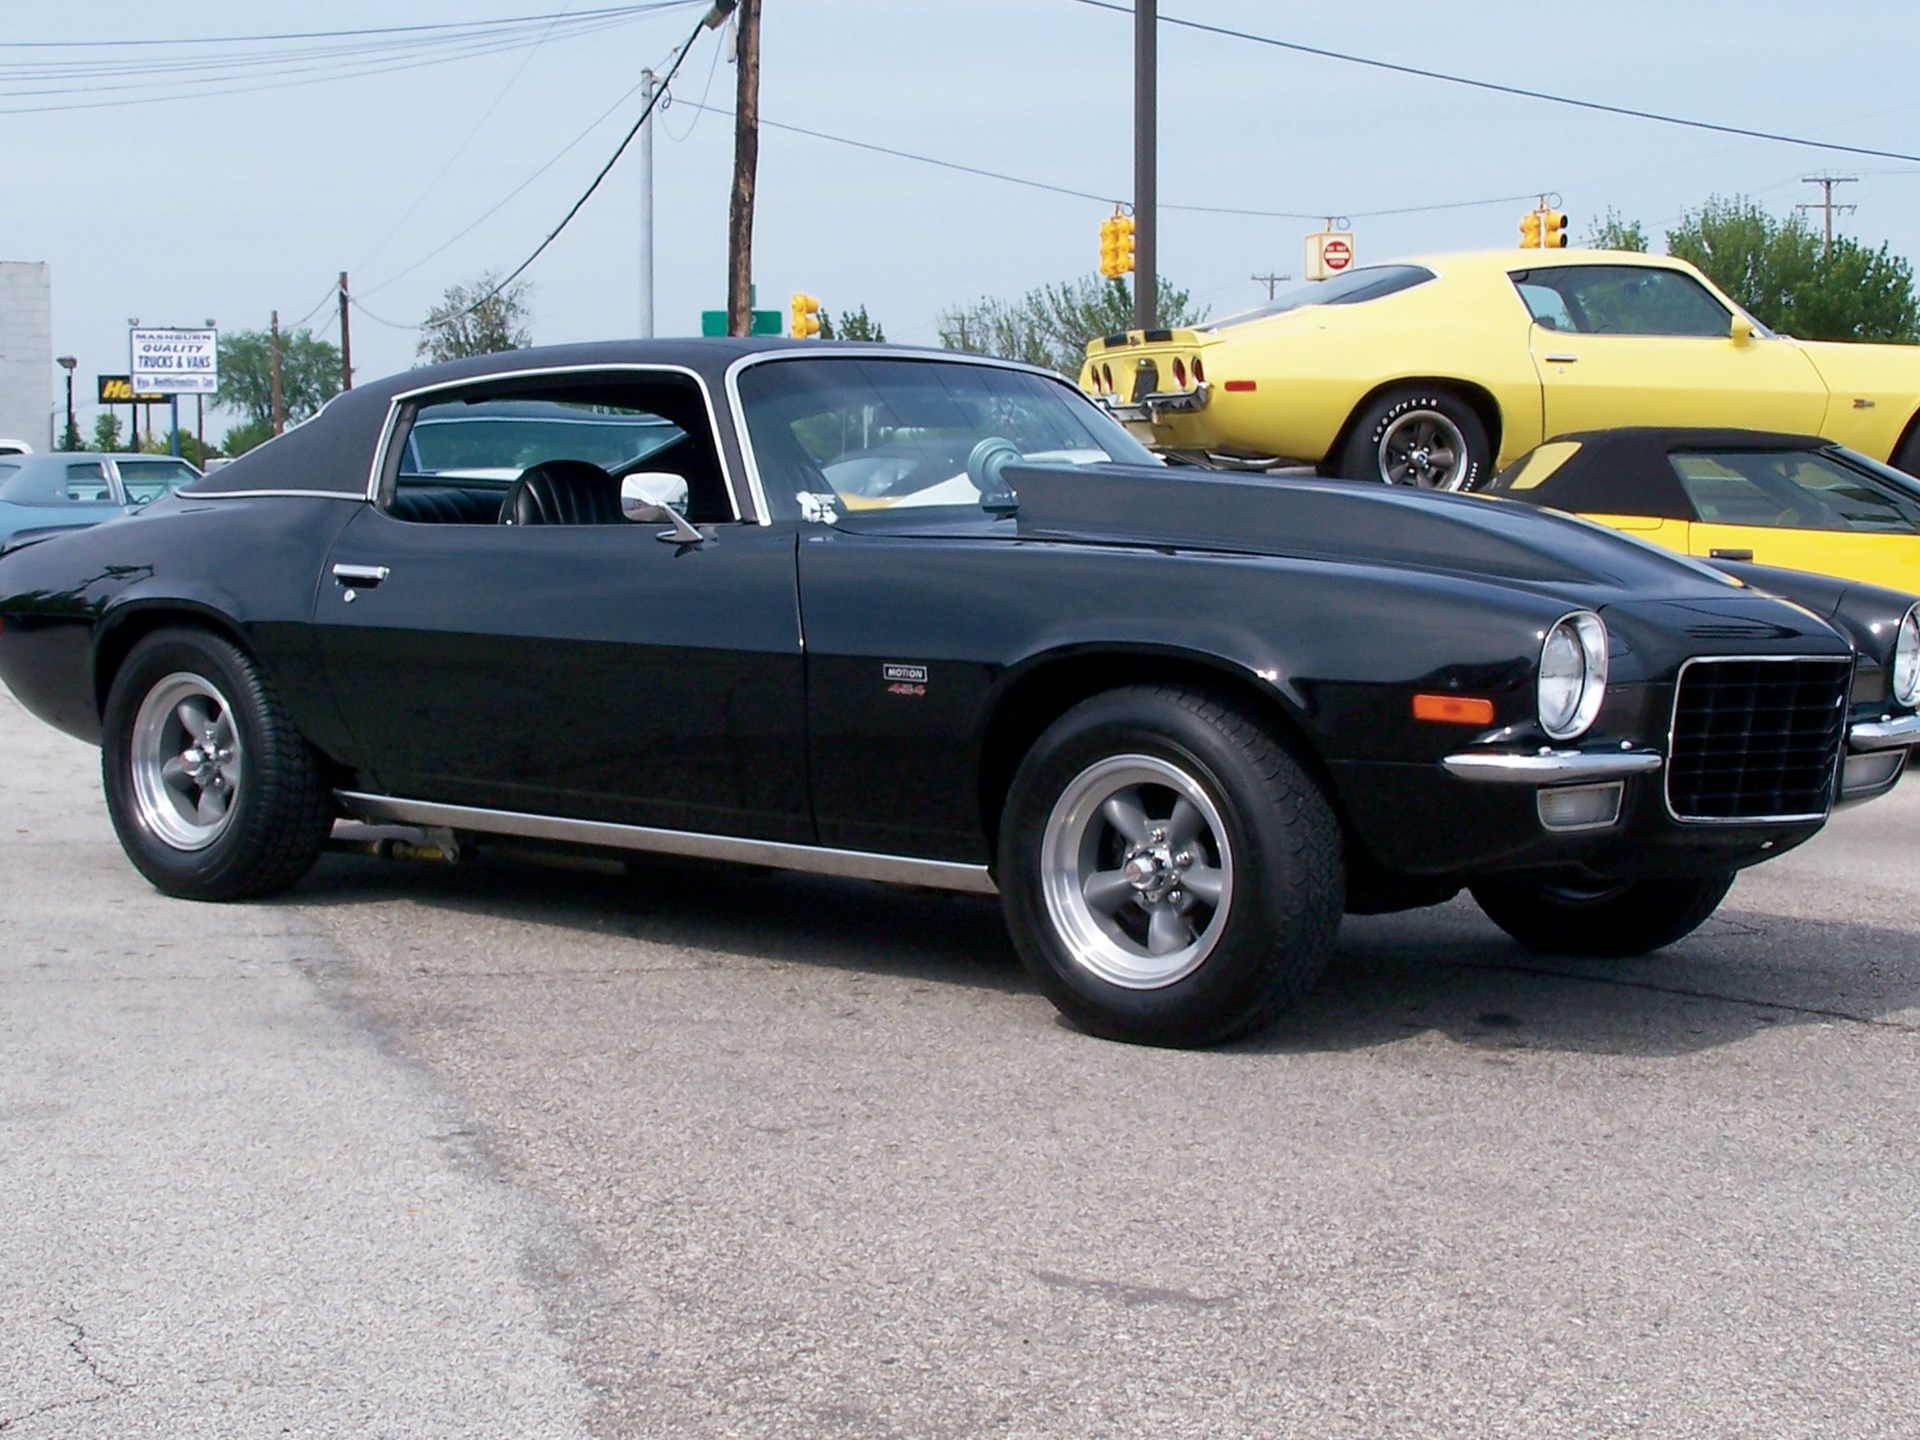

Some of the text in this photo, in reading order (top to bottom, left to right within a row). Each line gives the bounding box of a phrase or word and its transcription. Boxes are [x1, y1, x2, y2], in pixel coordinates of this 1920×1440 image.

[142, 344, 204, 353] QUALITY
[138, 355, 211, 369] TRUCKS & VANS
[887, 668, 923, 679] MOTION
